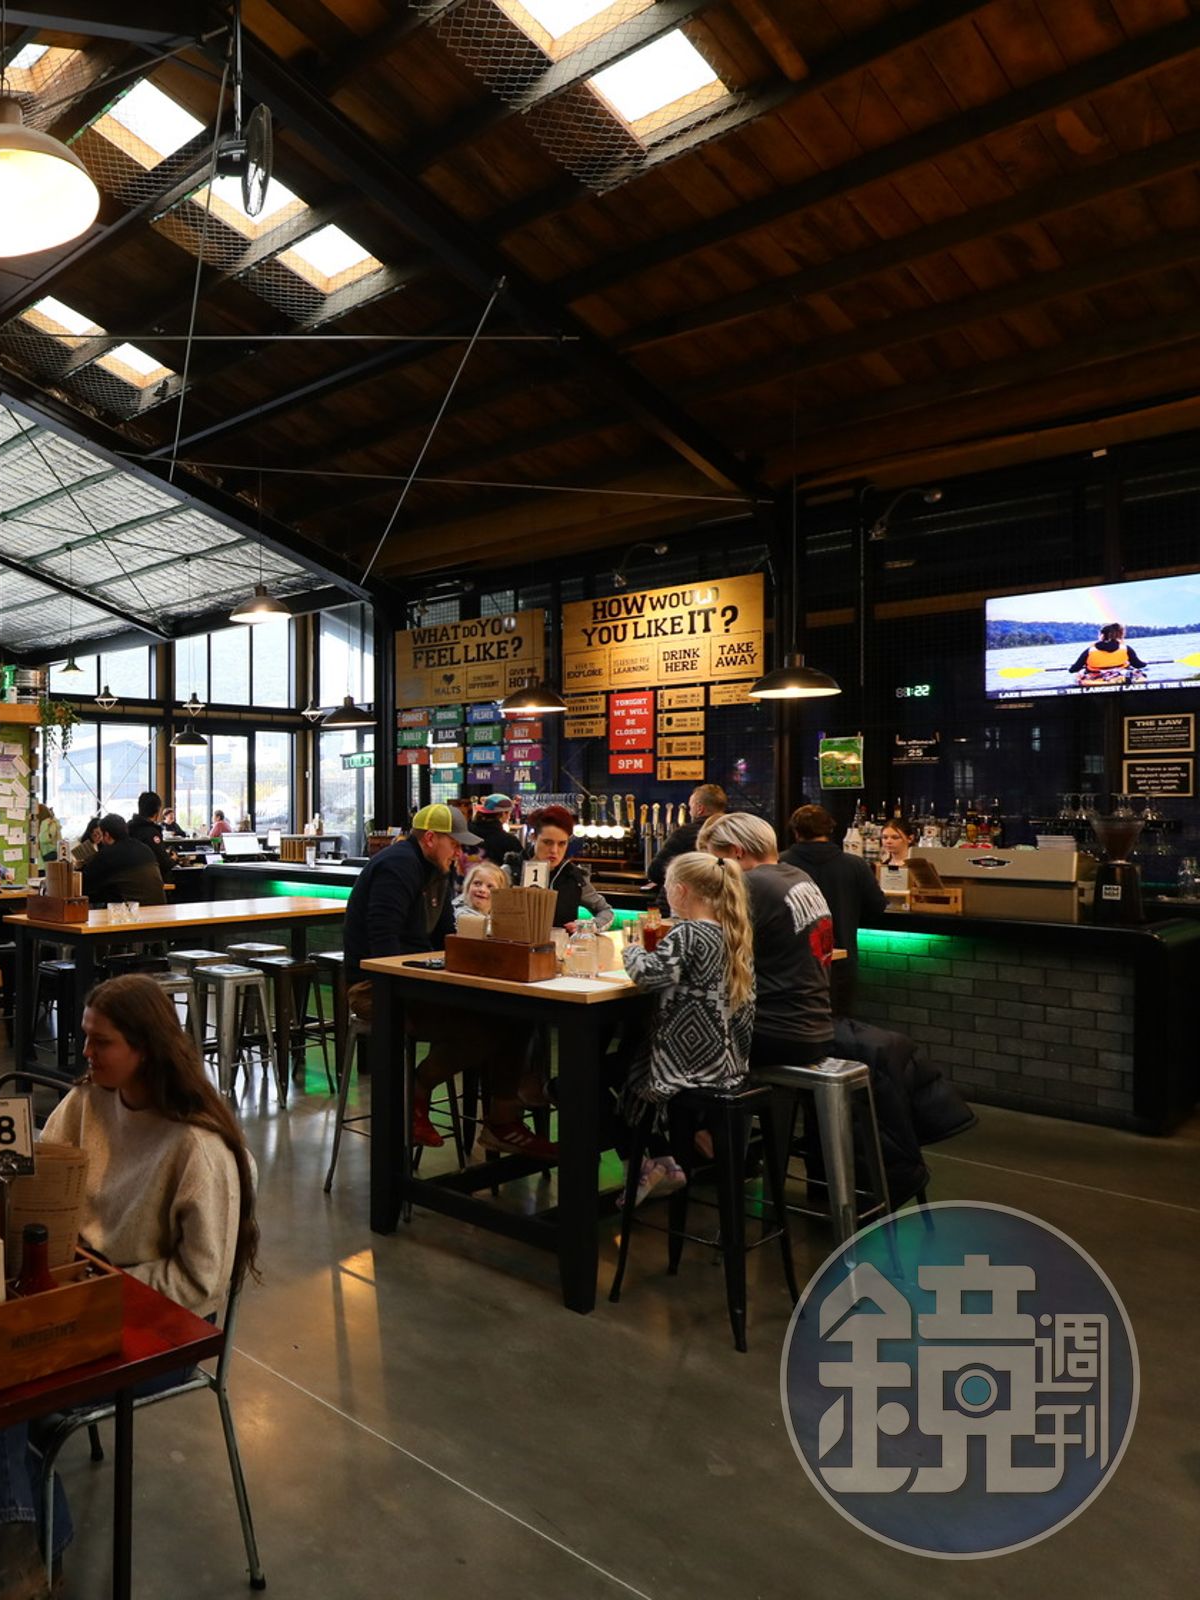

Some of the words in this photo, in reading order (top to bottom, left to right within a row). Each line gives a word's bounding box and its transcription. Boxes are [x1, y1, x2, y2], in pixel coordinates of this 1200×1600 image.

[592, 594, 647, 620] HOW
[412, 624, 460, 645] WHAT
[462, 625, 478, 639] DO
[477, 617, 517, 637] YOU
[582, 623, 627, 647] YOU
[633, 615, 684, 640] LIKE
[413, 646, 461, 669] FEEL
[463, 636, 523, 663] LIKE?
[662, 648, 700, 661] DRINK
[718, 642, 754, 655] TAKE
[665, 660, 698, 672] HERE
[715, 653, 758, 668] AWAY
[615, 698, 648, 707] TONIGHT
[613, 709, 626, 717] WE
[438, 730, 457, 740] BLACK
[513, 728, 529, 738] HAZY
[615, 728, 647, 736] CLOSING
[625, 737, 637, 746] AT
[513, 749, 530, 758] HAZY
[617, 758, 644, 770] 9PM
[513, 770, 531, 783] APA
[532, 869, 539, 882] 1
